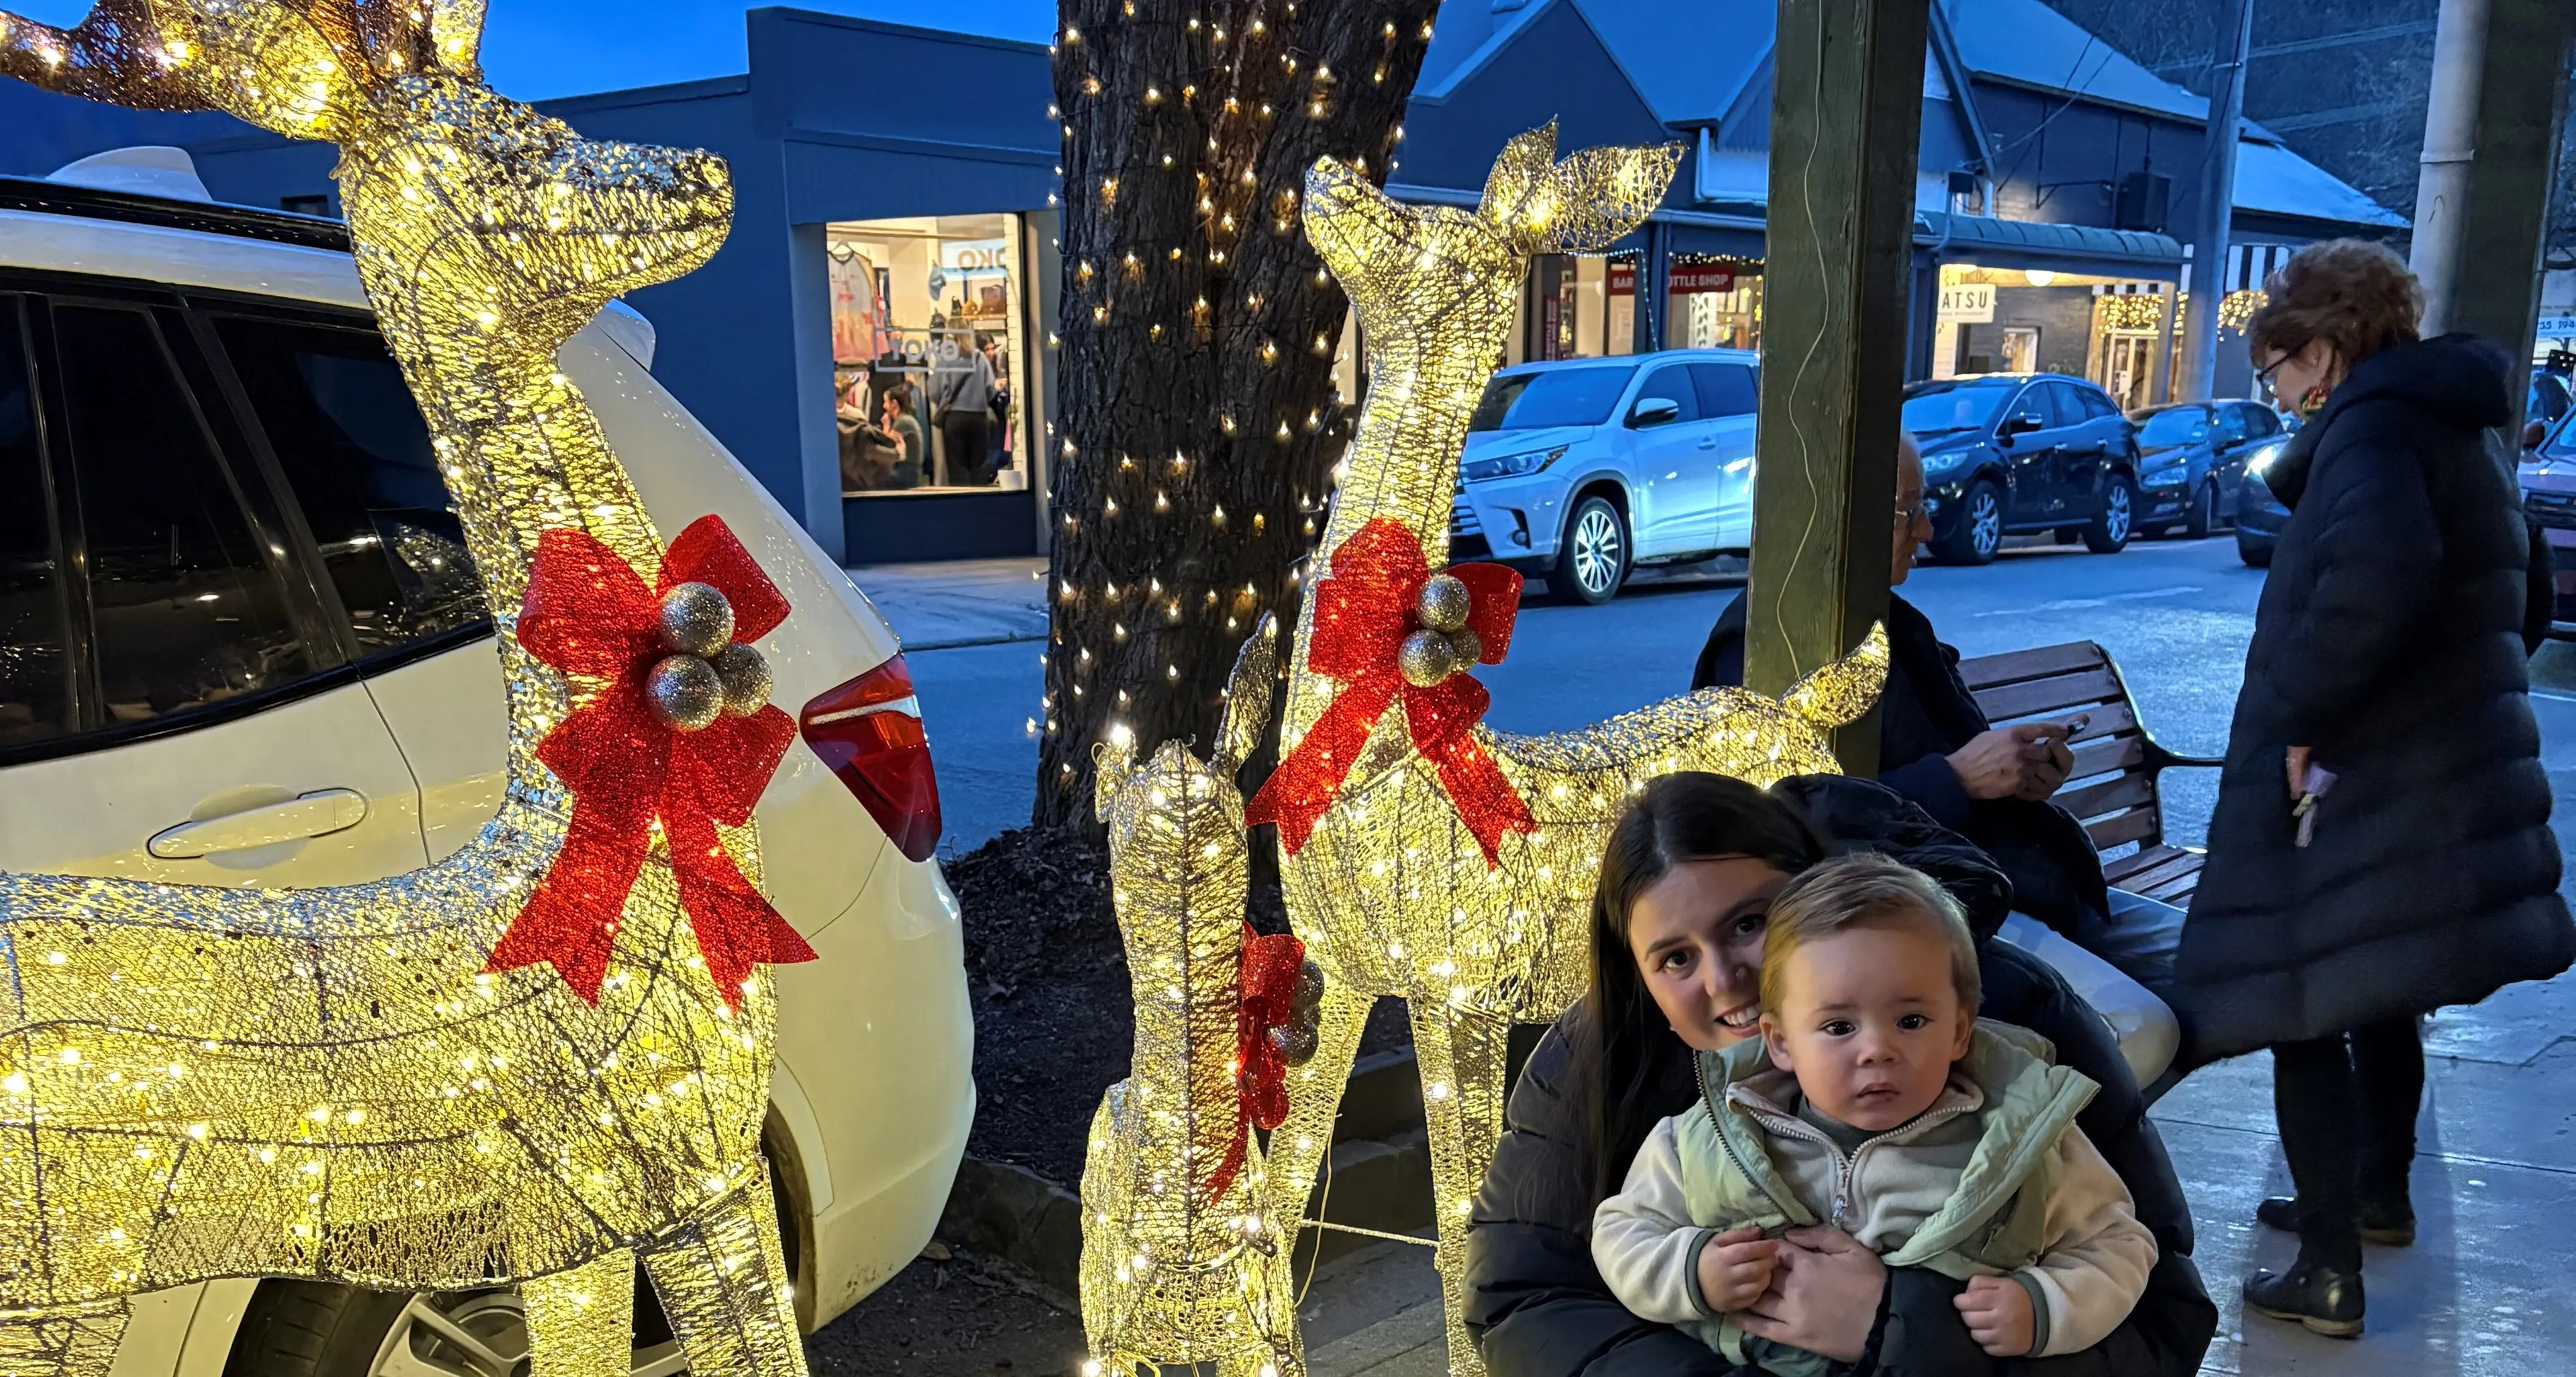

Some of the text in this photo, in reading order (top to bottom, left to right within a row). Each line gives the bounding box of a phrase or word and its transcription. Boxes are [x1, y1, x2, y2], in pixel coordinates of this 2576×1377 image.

[1613, 276, 1633, 289] BAR
[1698, 274, 1729, 287] SHOP
[1941, 291, 1988, 309] ATSU
